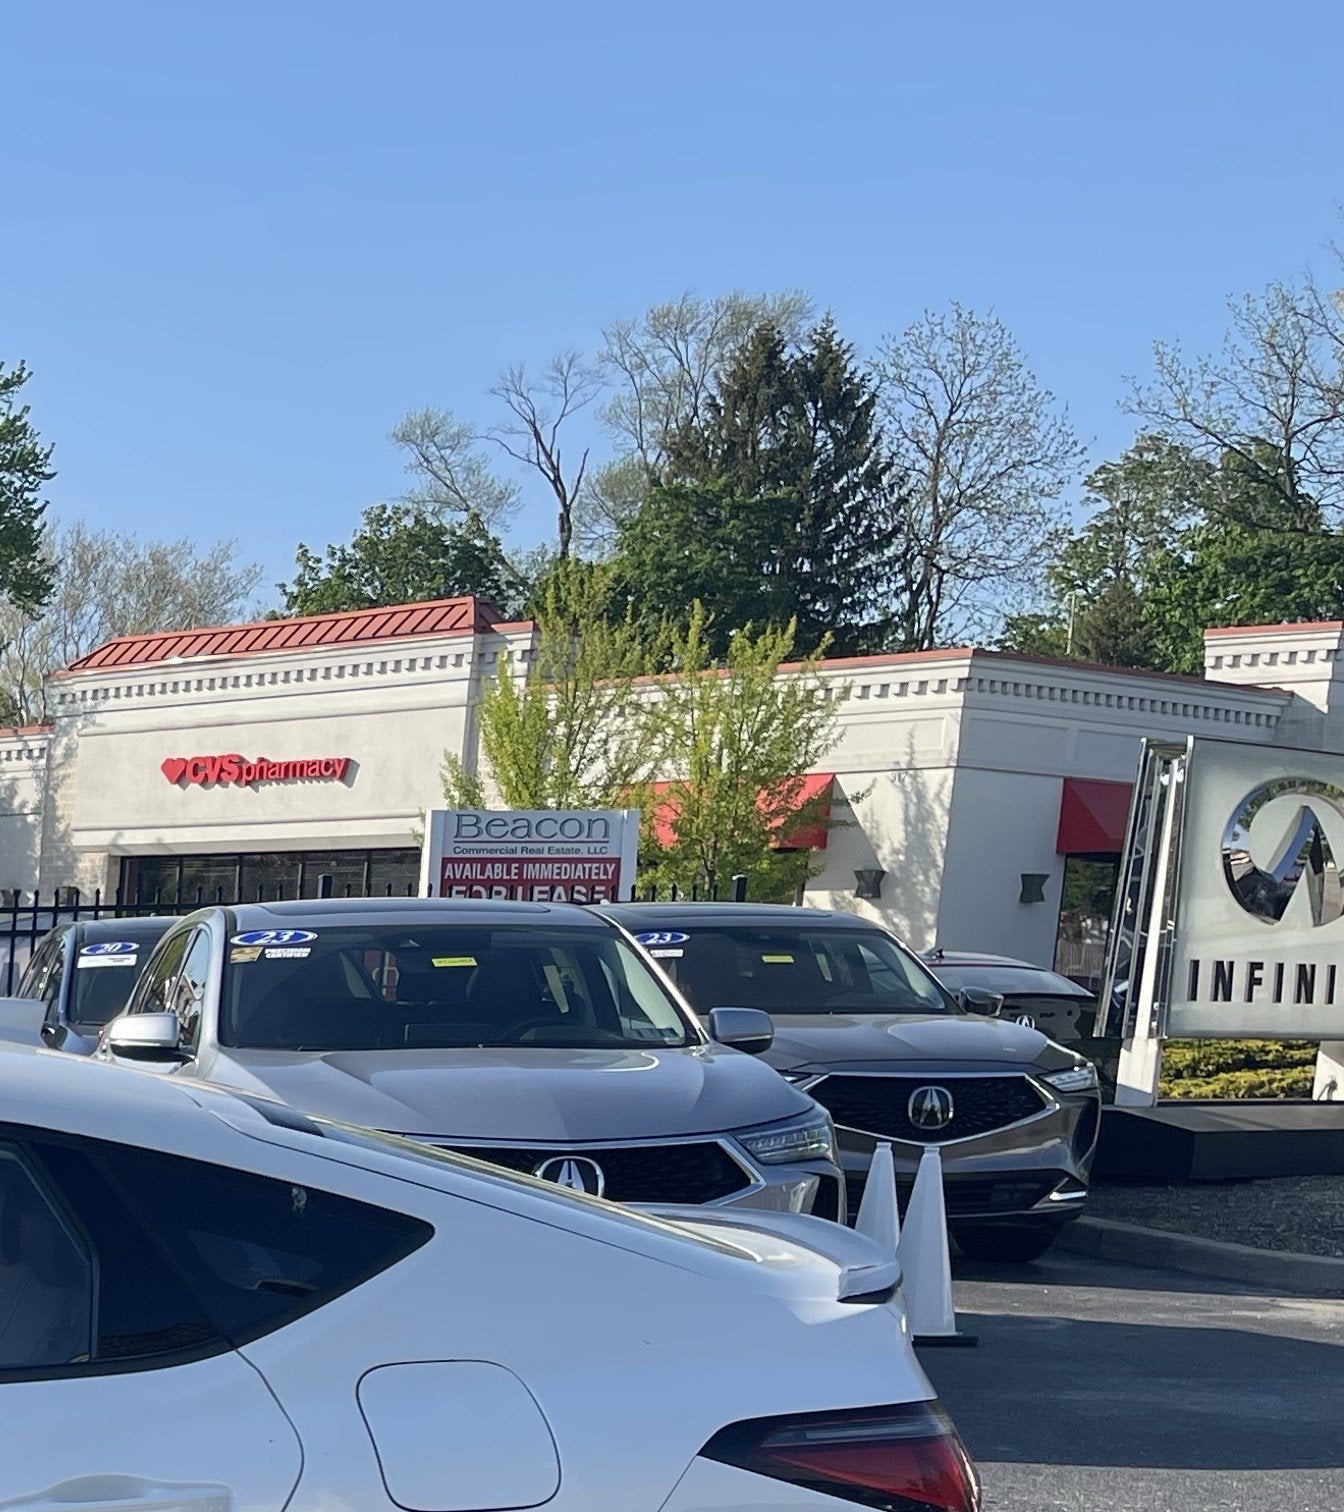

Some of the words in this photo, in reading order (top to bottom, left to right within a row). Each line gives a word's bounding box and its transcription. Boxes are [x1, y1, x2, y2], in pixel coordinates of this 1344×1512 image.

[185, 754, 241, 784] CVS
[241, 757, 347, 786] pharmacy
[454, 813, 610, 839] Beacon
[453, 846, 518, 855] Commercial
[520, 846, 544, 855] Real
[547, 846, 583, 856] Estate,
[587, 846, 608, 855] LLC
[444, 863, 519, 880] AVAILABLE
[523, 863, 616, 880] IMMEDIATELY
[450, 885, 507, 901] FOR
[516, 885, 607, 902] LEASE
[252, 930, 295, 946] 23
[646, 932, 672, 944] 23
[96, 942, 123, 954] 20
[1187, 959, 1337, 1005] INFINI
